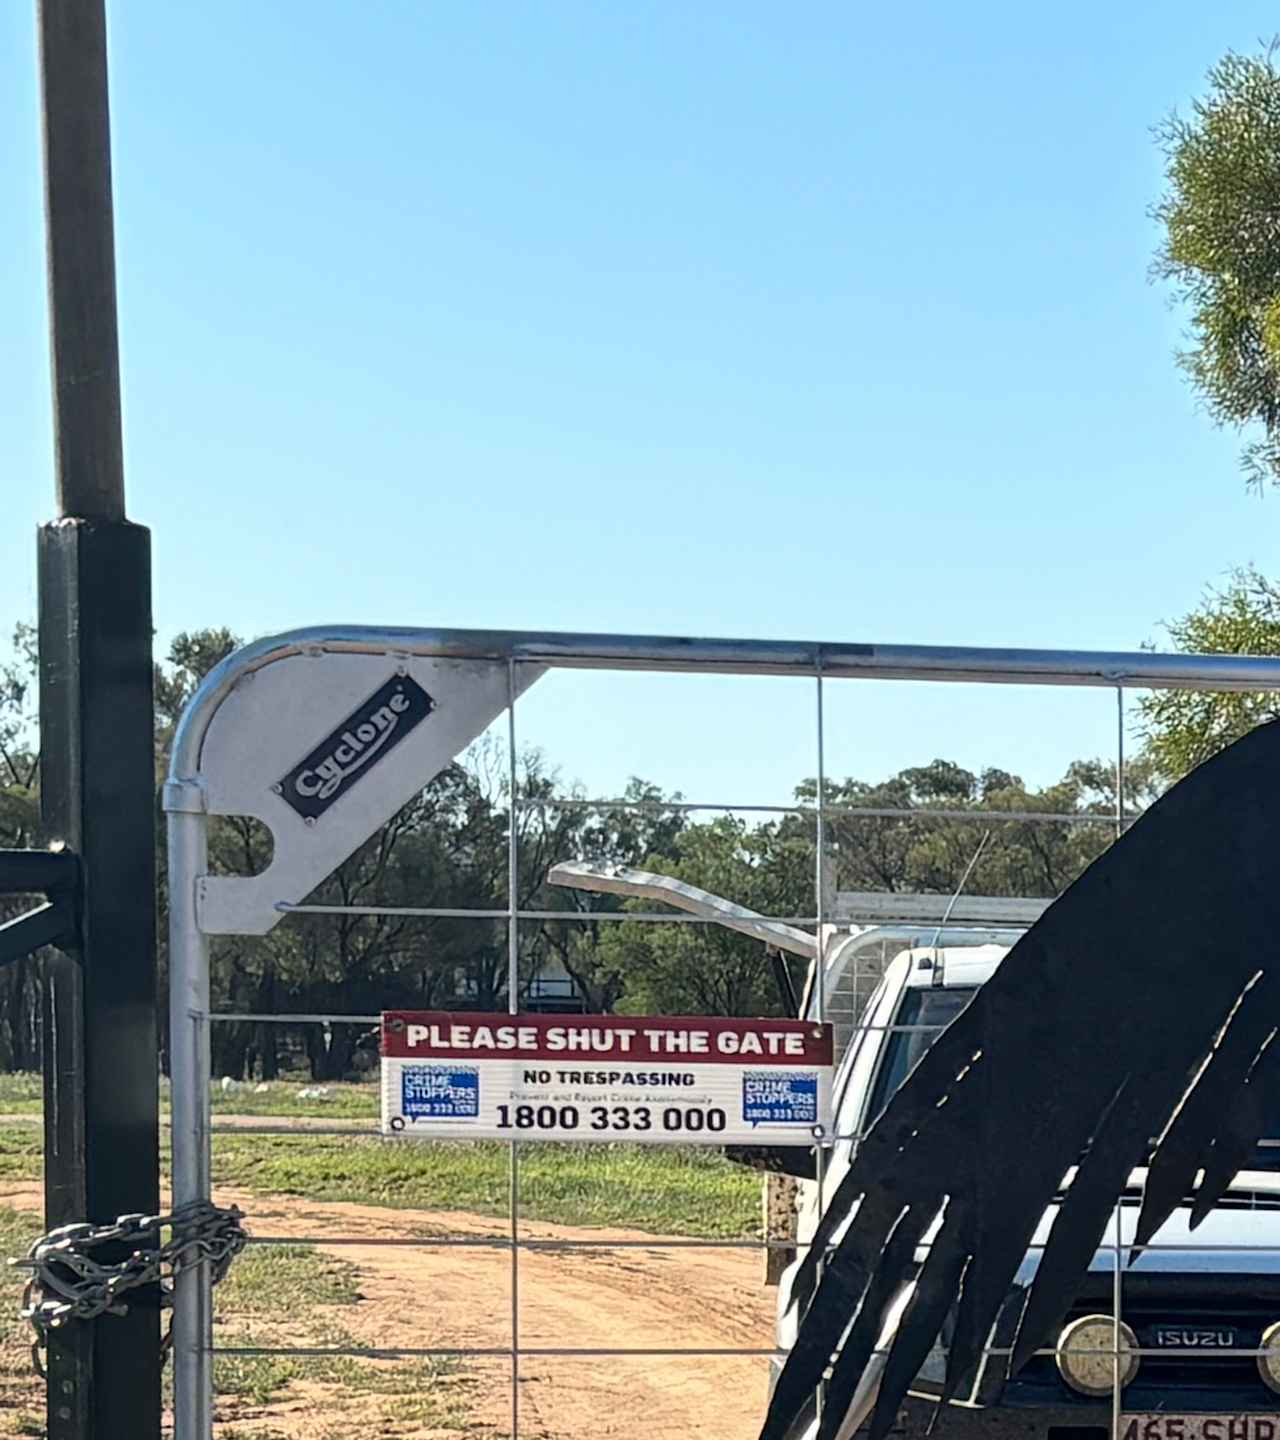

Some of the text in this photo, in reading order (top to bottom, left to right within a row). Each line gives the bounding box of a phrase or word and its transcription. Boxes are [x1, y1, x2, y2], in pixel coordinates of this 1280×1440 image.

[295, 691, 410, 800] Cyclone
[407, 1025, 805, 1055] PLEASE SHUT THE GATE
[404, 1074, 450, 1087] CRIME
[523, 1070, 696, 1087] NO TRESPASSING
[745, 1080, 793, 1093] CRIME
[404, 1086, 476, 1099] STOPPERS
[745, 1092, 815, 1105] STOPPERS
[496, 1104, 727, 1132] 1800 333 000
[1157, 1330, 1234, 1346] ISUZU
